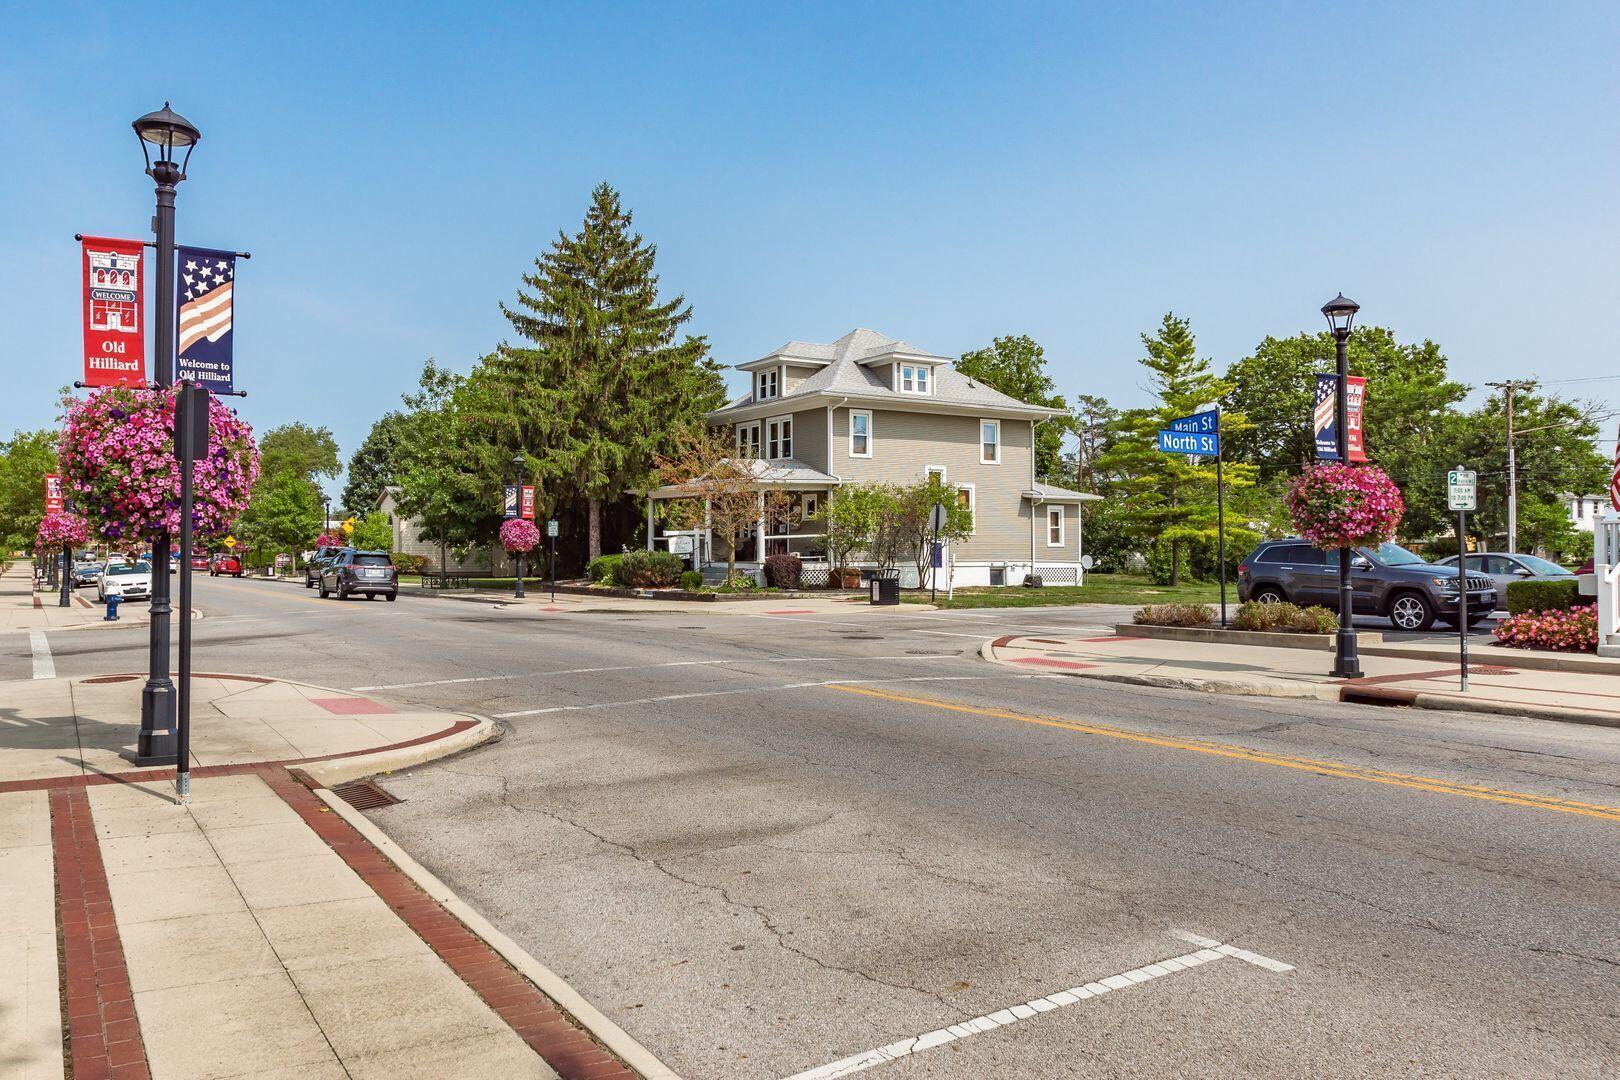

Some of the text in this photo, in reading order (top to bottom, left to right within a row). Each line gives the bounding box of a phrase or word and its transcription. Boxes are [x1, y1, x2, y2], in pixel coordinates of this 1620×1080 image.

[95, 291, 132, 301] WELCOME
[101, 340, 126, 354] Old
[89, 356, 139, 371] Hilliard
[179, 358, 230, 371] Welcome to
[179, 369, 231, 382] Old Hilliard
[1174, 416, 1213, 432] Main St
[1163, 433, 1214, 451] North St
[1450, 473, 1457, 484] 2
